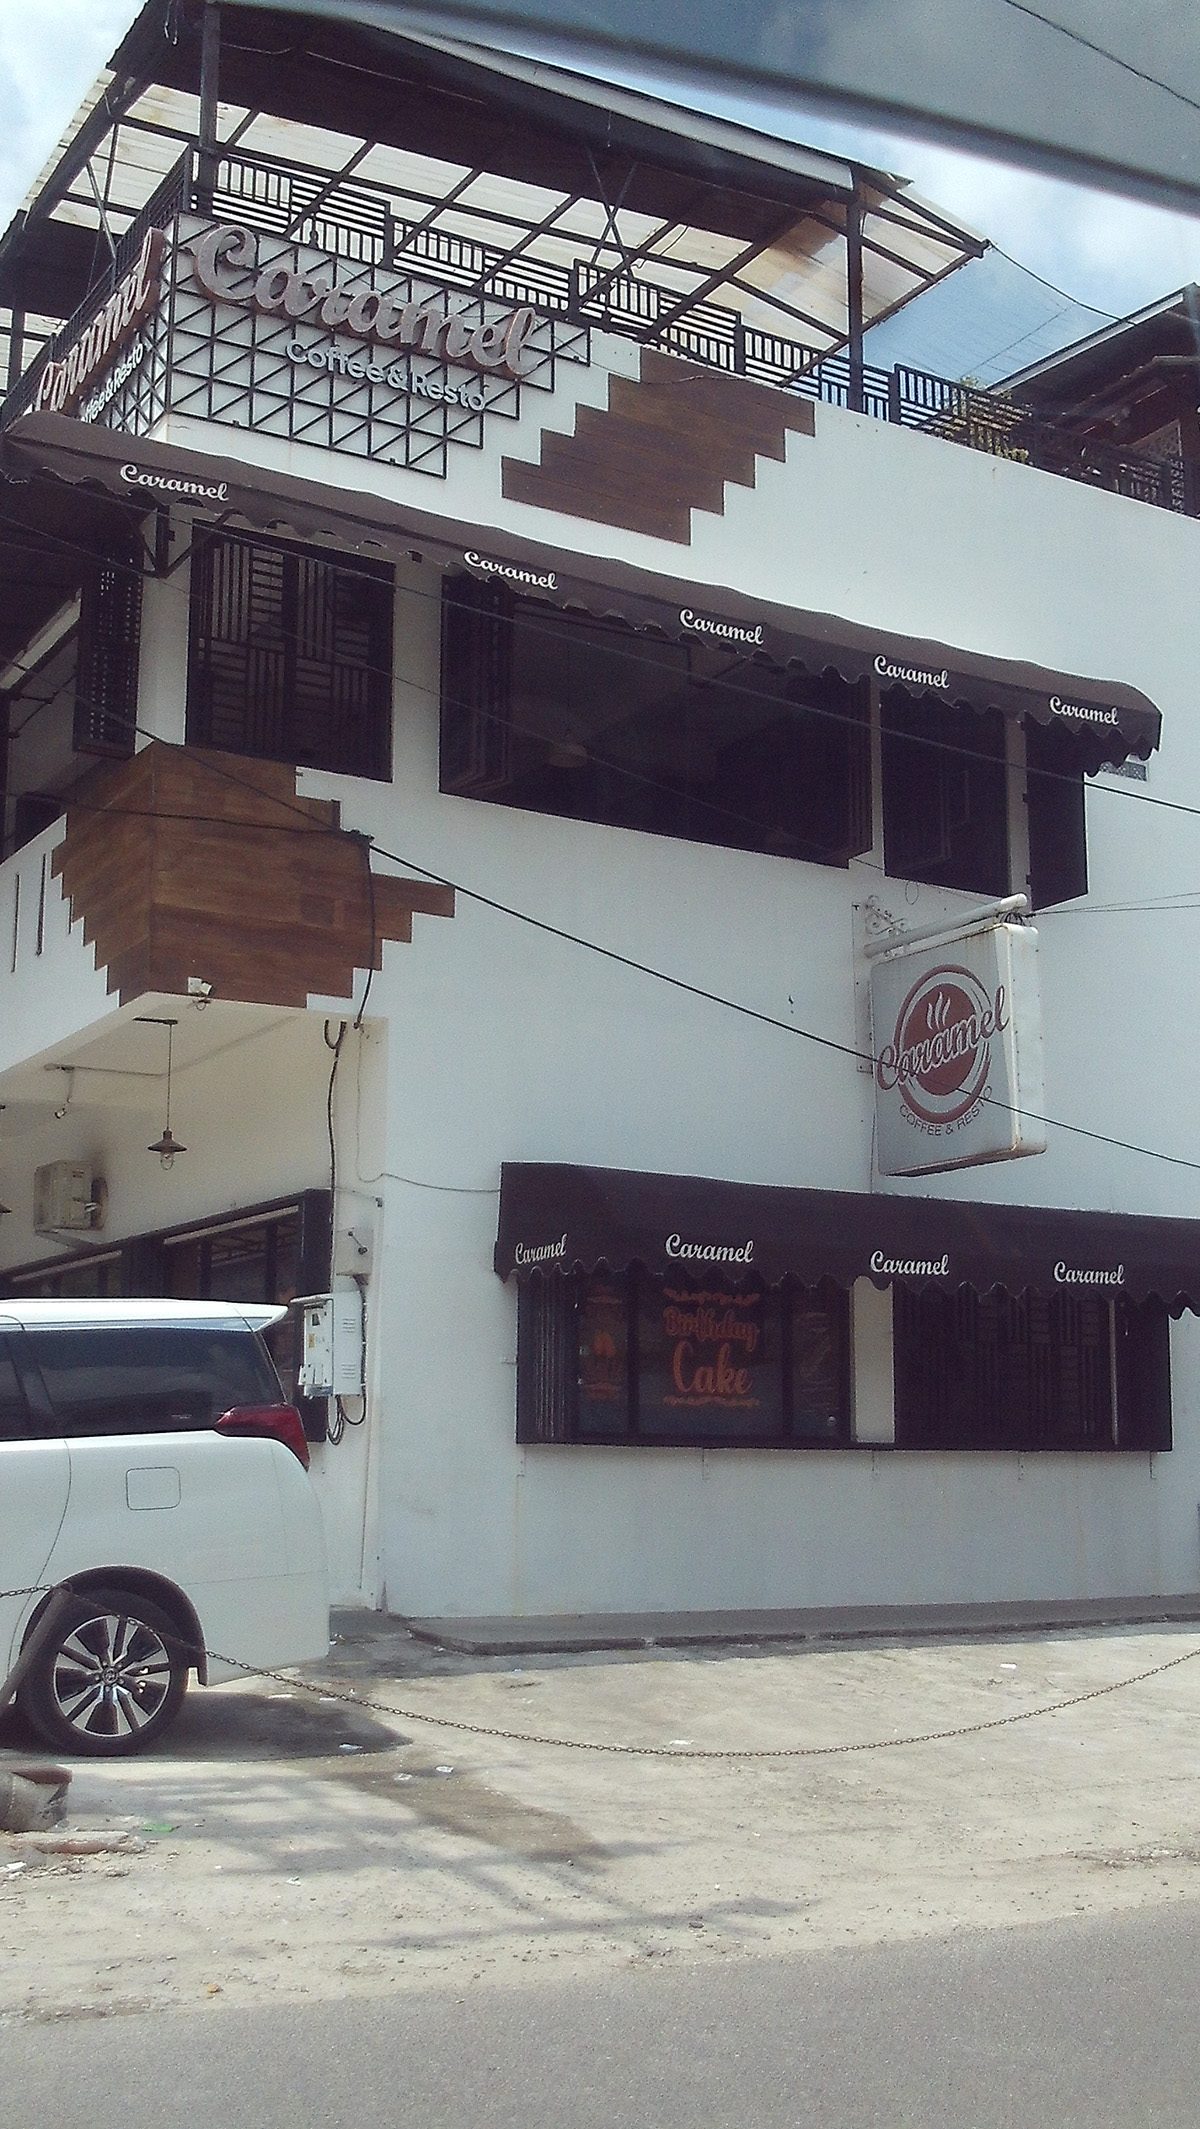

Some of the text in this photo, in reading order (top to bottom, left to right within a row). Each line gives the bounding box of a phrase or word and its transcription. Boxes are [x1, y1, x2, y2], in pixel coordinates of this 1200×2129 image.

[192, 224, 539, 376] Caramel
[120, 464, 229, 501] Caramel
[464, 551, 559, 590] Caramel
[680, 608, 764, 645] Caramel
[874, 655, 950, 689] Caramel
[1050, 696, 1119, 725] Caramel
[877, 985, 1010, 1091] Caramel
[899, 1103, 942, 1136] COFFEE
[515, 1233, 567, 1265] Caramel
[665, 1233, 754, 1263] Caramel
[870, 1250, 949, 1275] Caramel
[1053, 1261, 1125, 1285] Caramel
[673, 1340, 753, 1394] Cake
